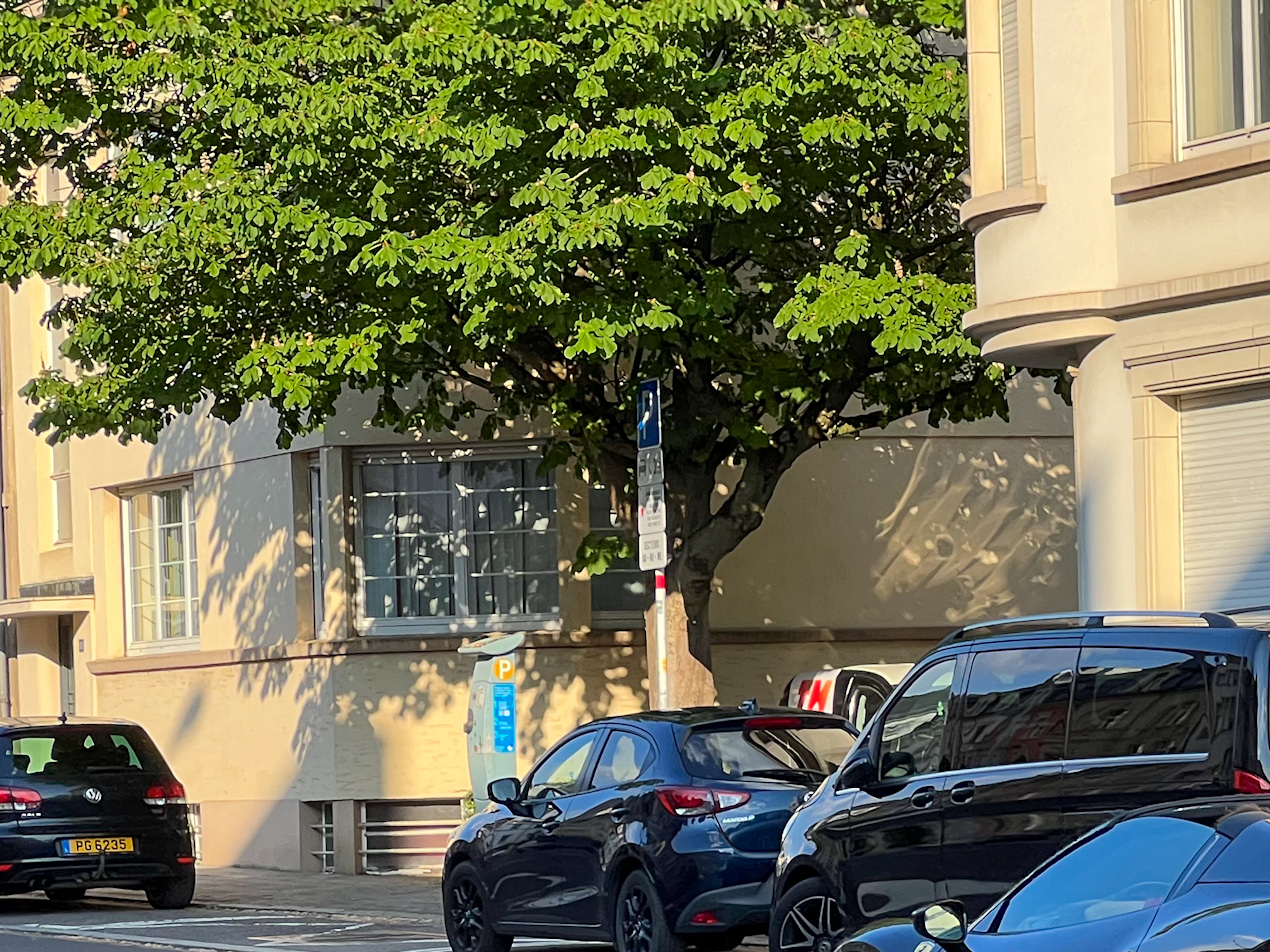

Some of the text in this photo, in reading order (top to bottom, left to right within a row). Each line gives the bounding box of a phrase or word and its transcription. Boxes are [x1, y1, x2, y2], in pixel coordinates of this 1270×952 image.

[500, 660, 511, 680] P
[76, 839, 126, 852] PG 6235
